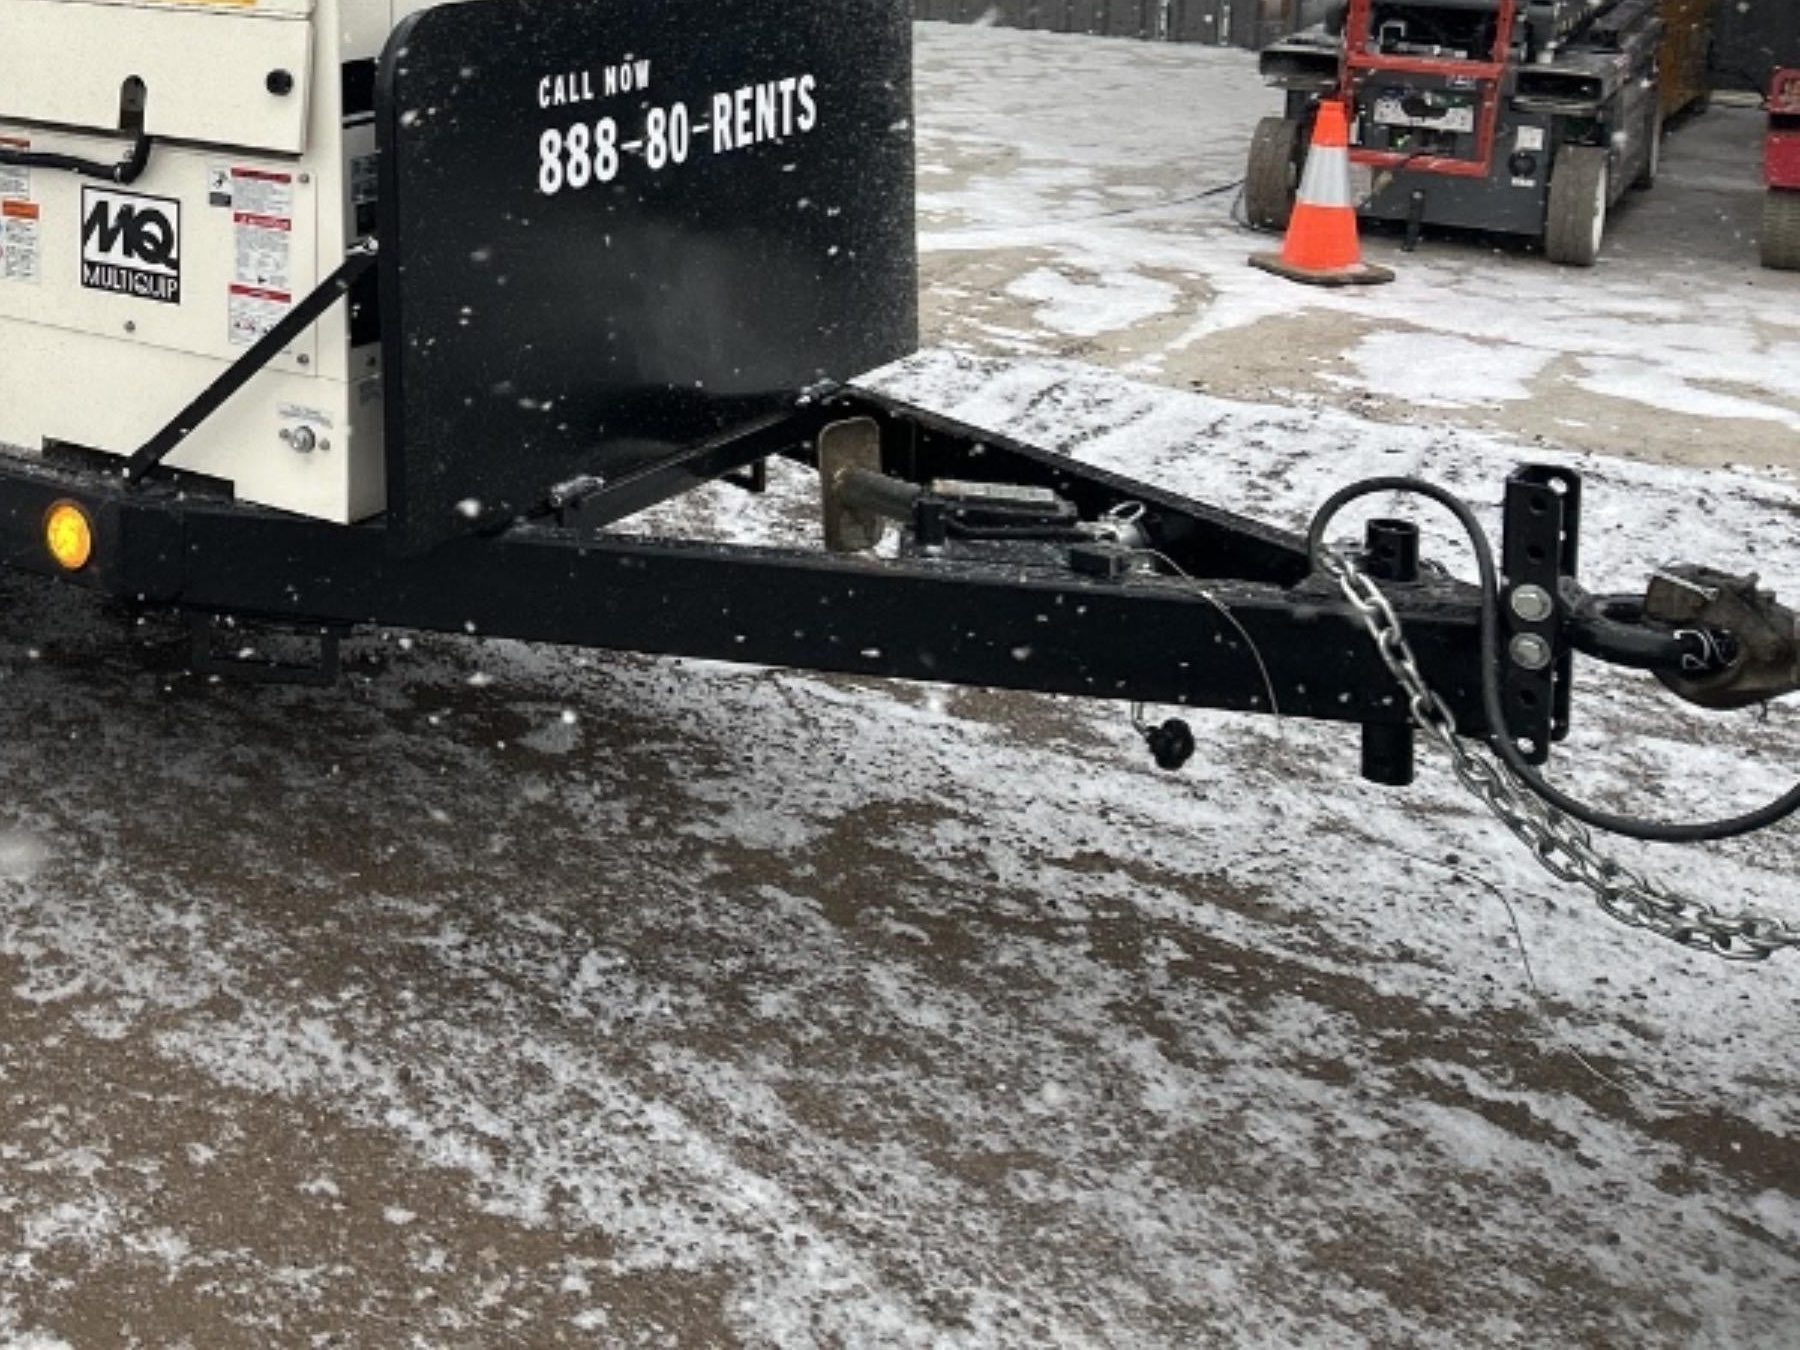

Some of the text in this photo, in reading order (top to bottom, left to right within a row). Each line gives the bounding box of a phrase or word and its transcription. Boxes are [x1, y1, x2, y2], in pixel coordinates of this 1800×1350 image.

[538, 58, 651, 109] CALL NOW
[538, 73, 818, 196] 888-80-RENTS
